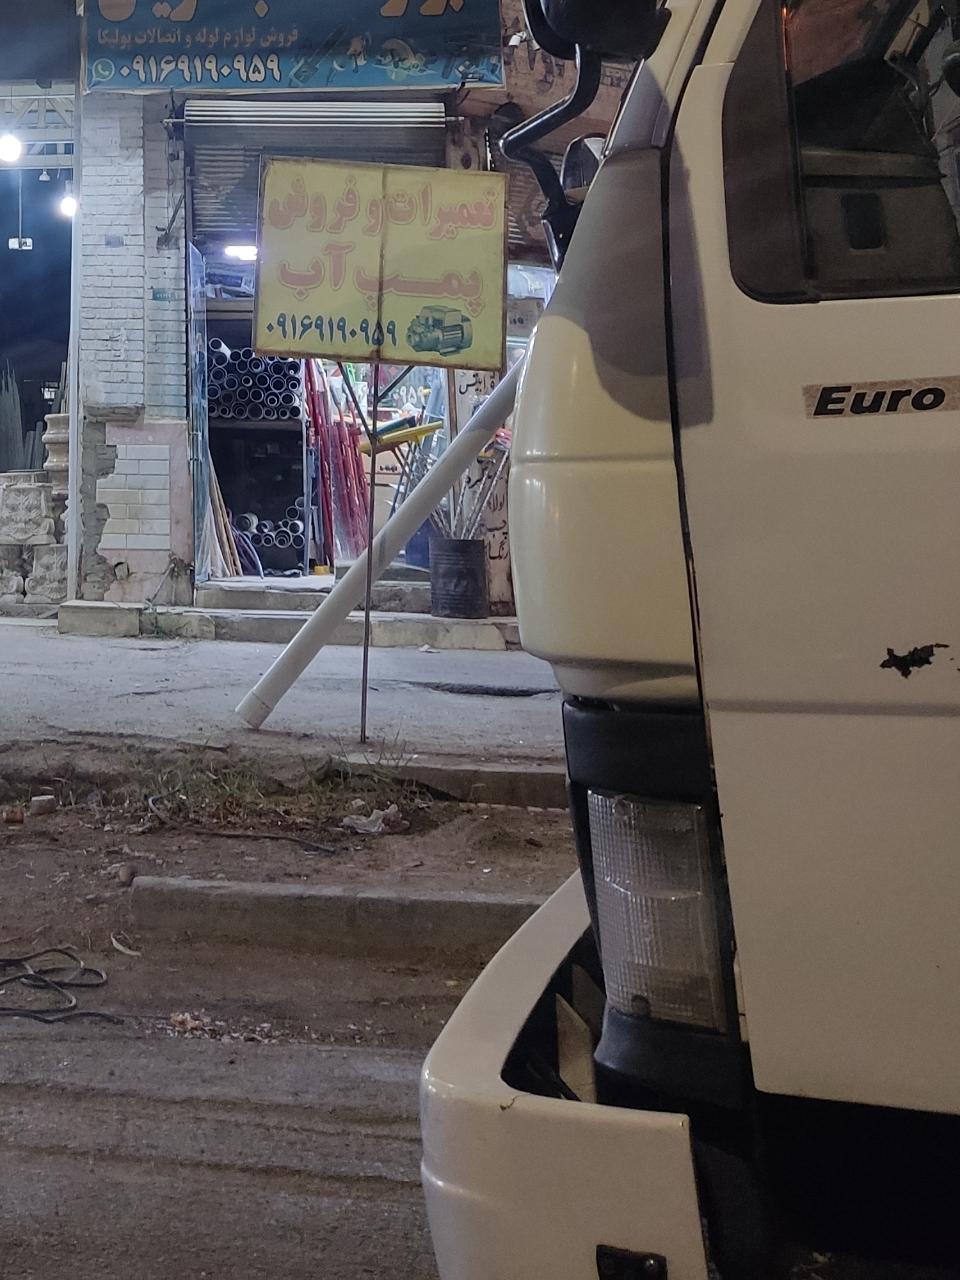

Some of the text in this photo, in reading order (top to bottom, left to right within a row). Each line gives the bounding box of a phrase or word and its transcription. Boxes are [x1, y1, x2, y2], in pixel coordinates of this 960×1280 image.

[194, 26, 219, 48] لوله
[223, 25, 256, 49] لوازم
[260, 26, 300, 48] فروش
[119, 53, 282, 83] ۰۹۱۶۹۱۹۰۹۵۹
[268, 174, 498, 241] تعمیرات و فروش
[277, 242, 486, 318] پمپ آب
[265, 312, 399, 348] ۰۹۱۶۹۱۹۰۹۵۹
[812, 385, 946, 417] Euro
